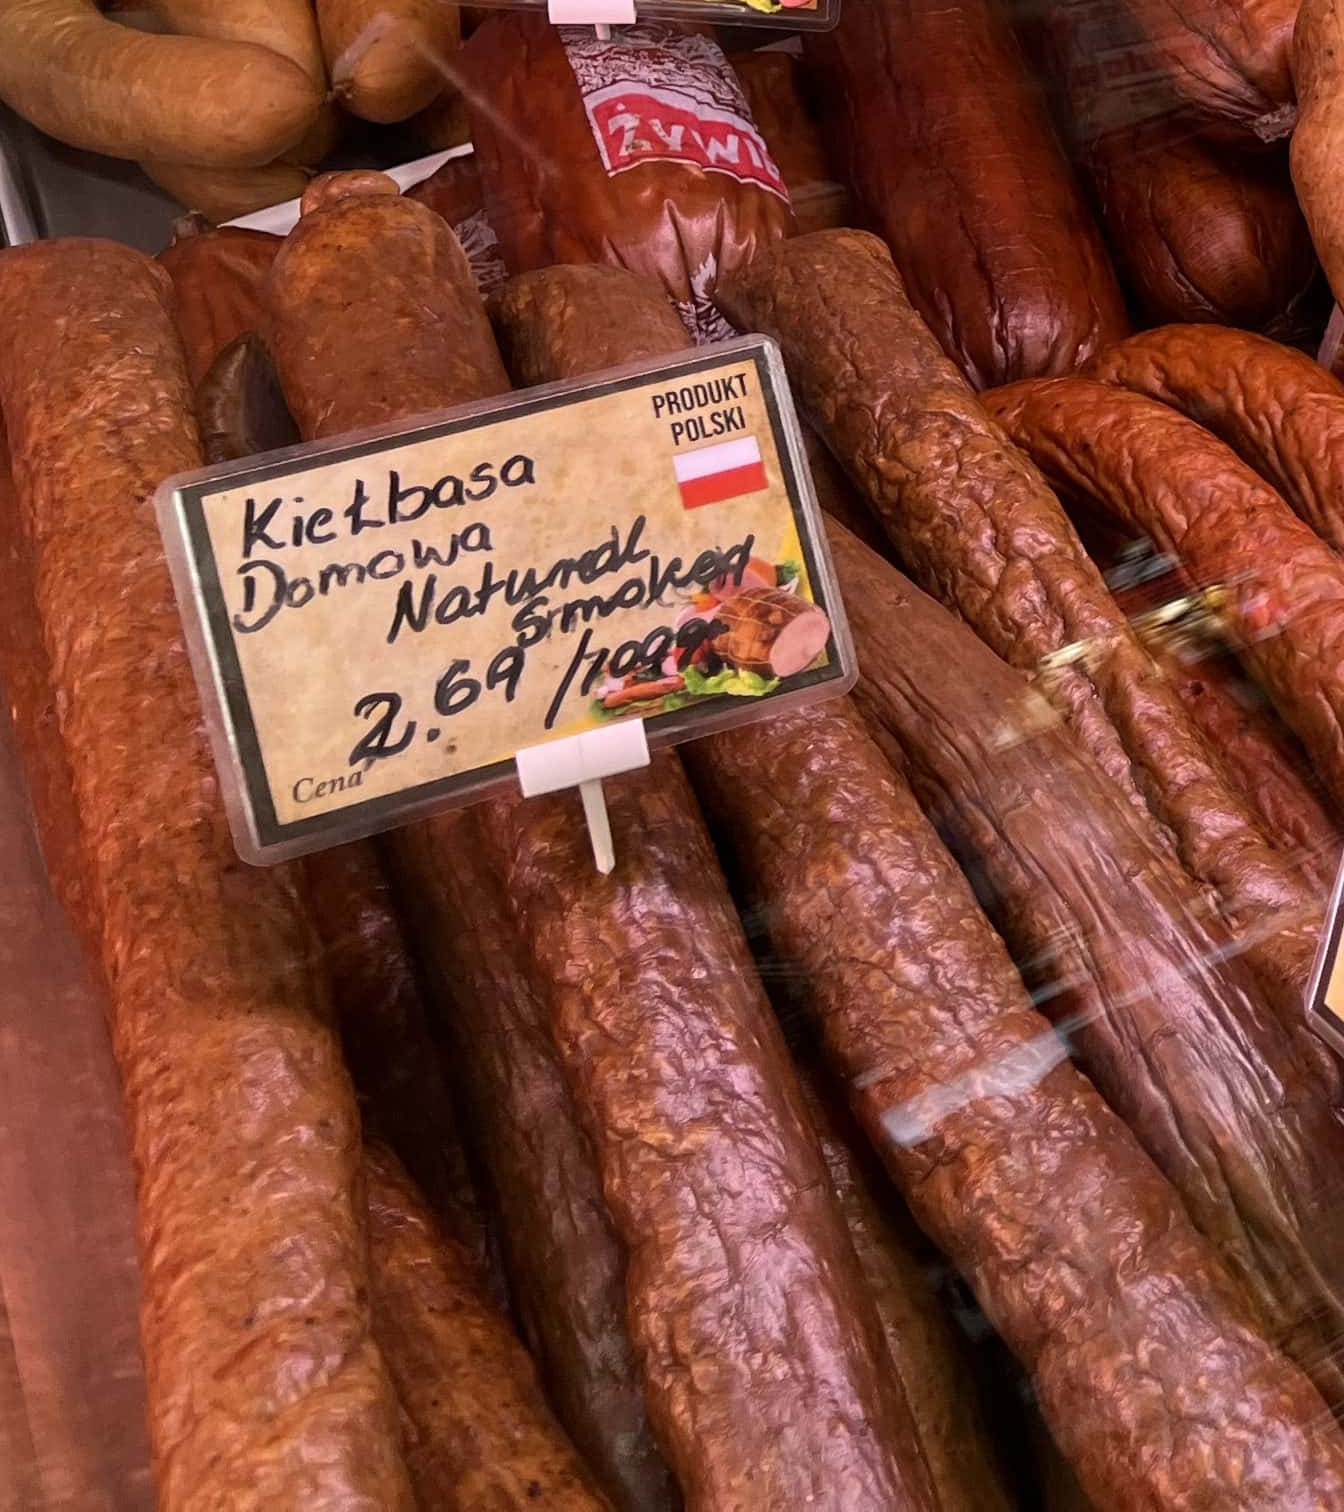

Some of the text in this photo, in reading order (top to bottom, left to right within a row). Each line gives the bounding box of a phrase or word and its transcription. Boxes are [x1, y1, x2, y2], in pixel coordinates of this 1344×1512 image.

[652, 373, 749, 418] PRODUKT
[670, 405, 746, 446] POLSKI
[240, 452, 536, 558] Kiełbasa
[232, 522, 493, 633] Domowa
[347, 646, 527, 769] 2.69
[291, 773, 364, 804] Cena
